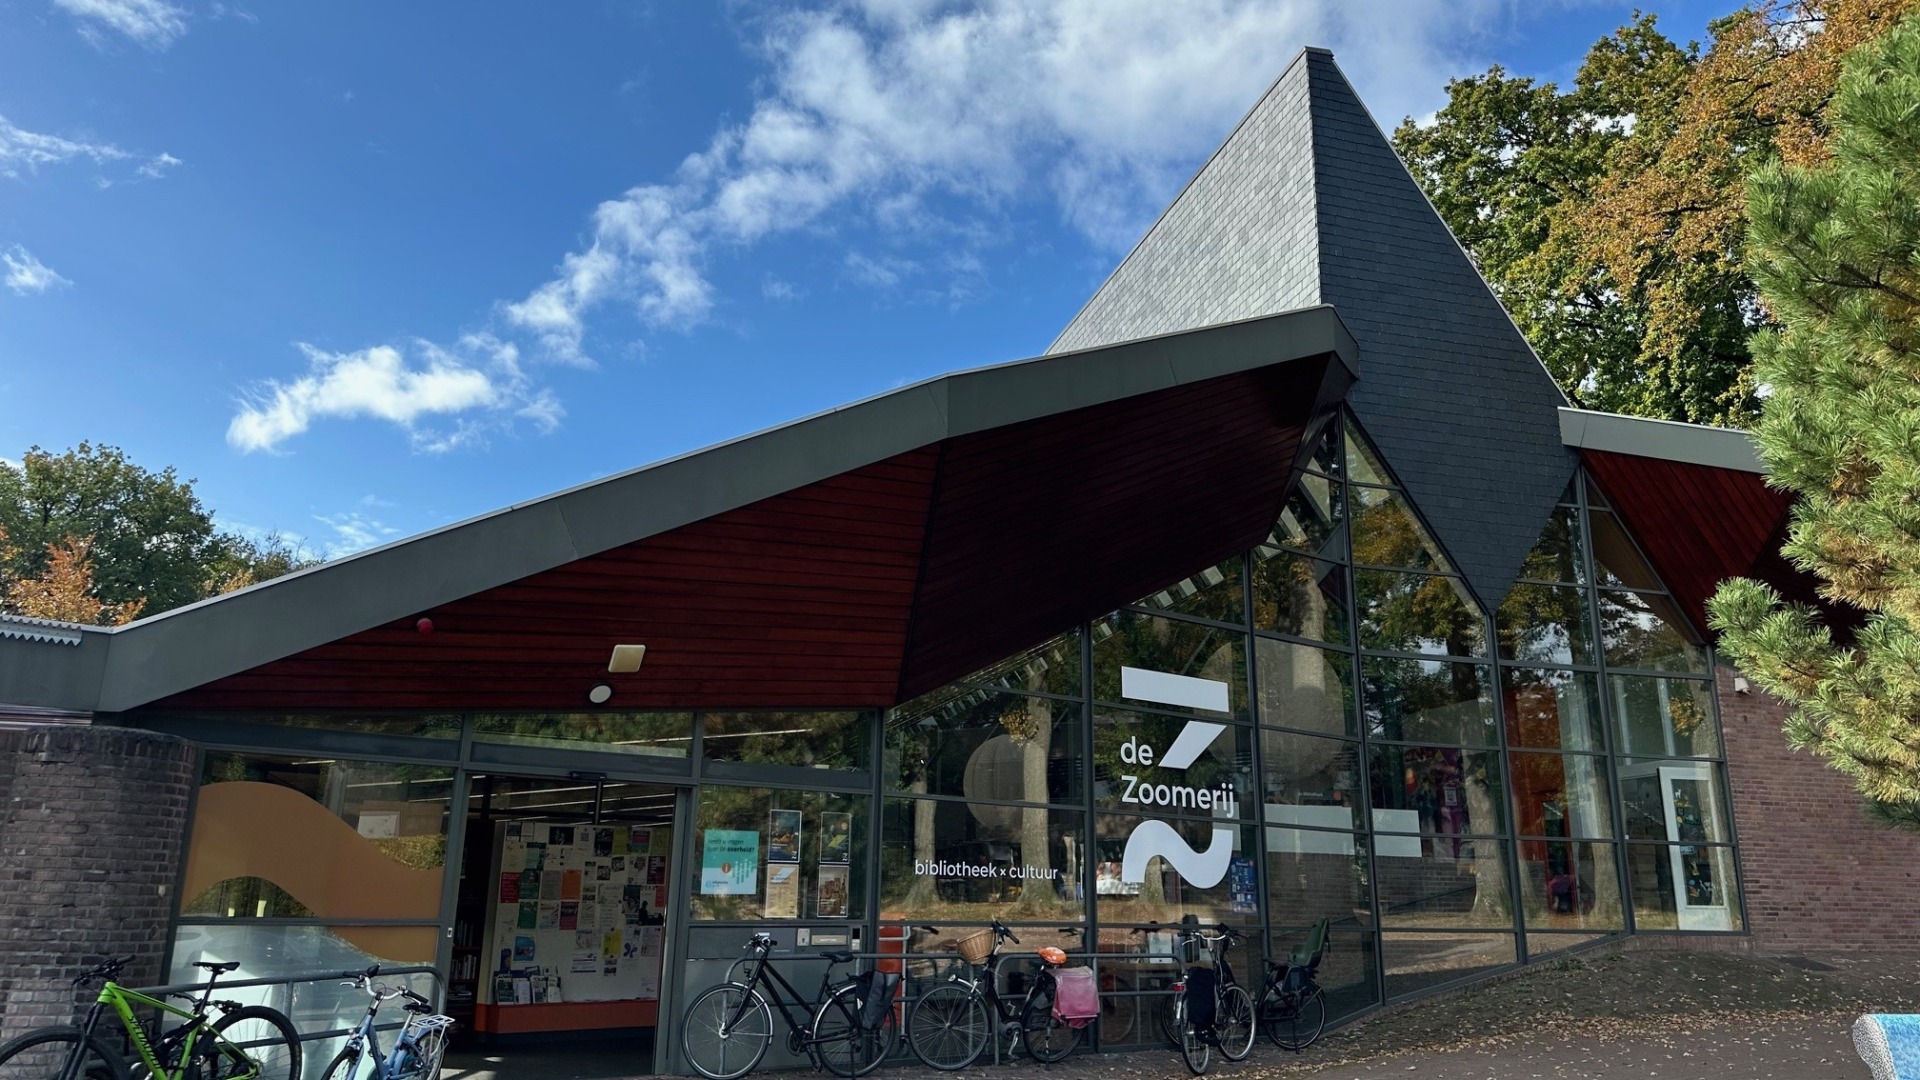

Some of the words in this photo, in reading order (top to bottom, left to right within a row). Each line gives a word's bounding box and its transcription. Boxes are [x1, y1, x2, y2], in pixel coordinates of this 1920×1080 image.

[1120, 735, 1154, 766] de
[1121, 774, 1235, 819] Zoomerij
[914, 859, 998, 878] bibliotheek
[1008, 864, 1059, 880] cultuur
